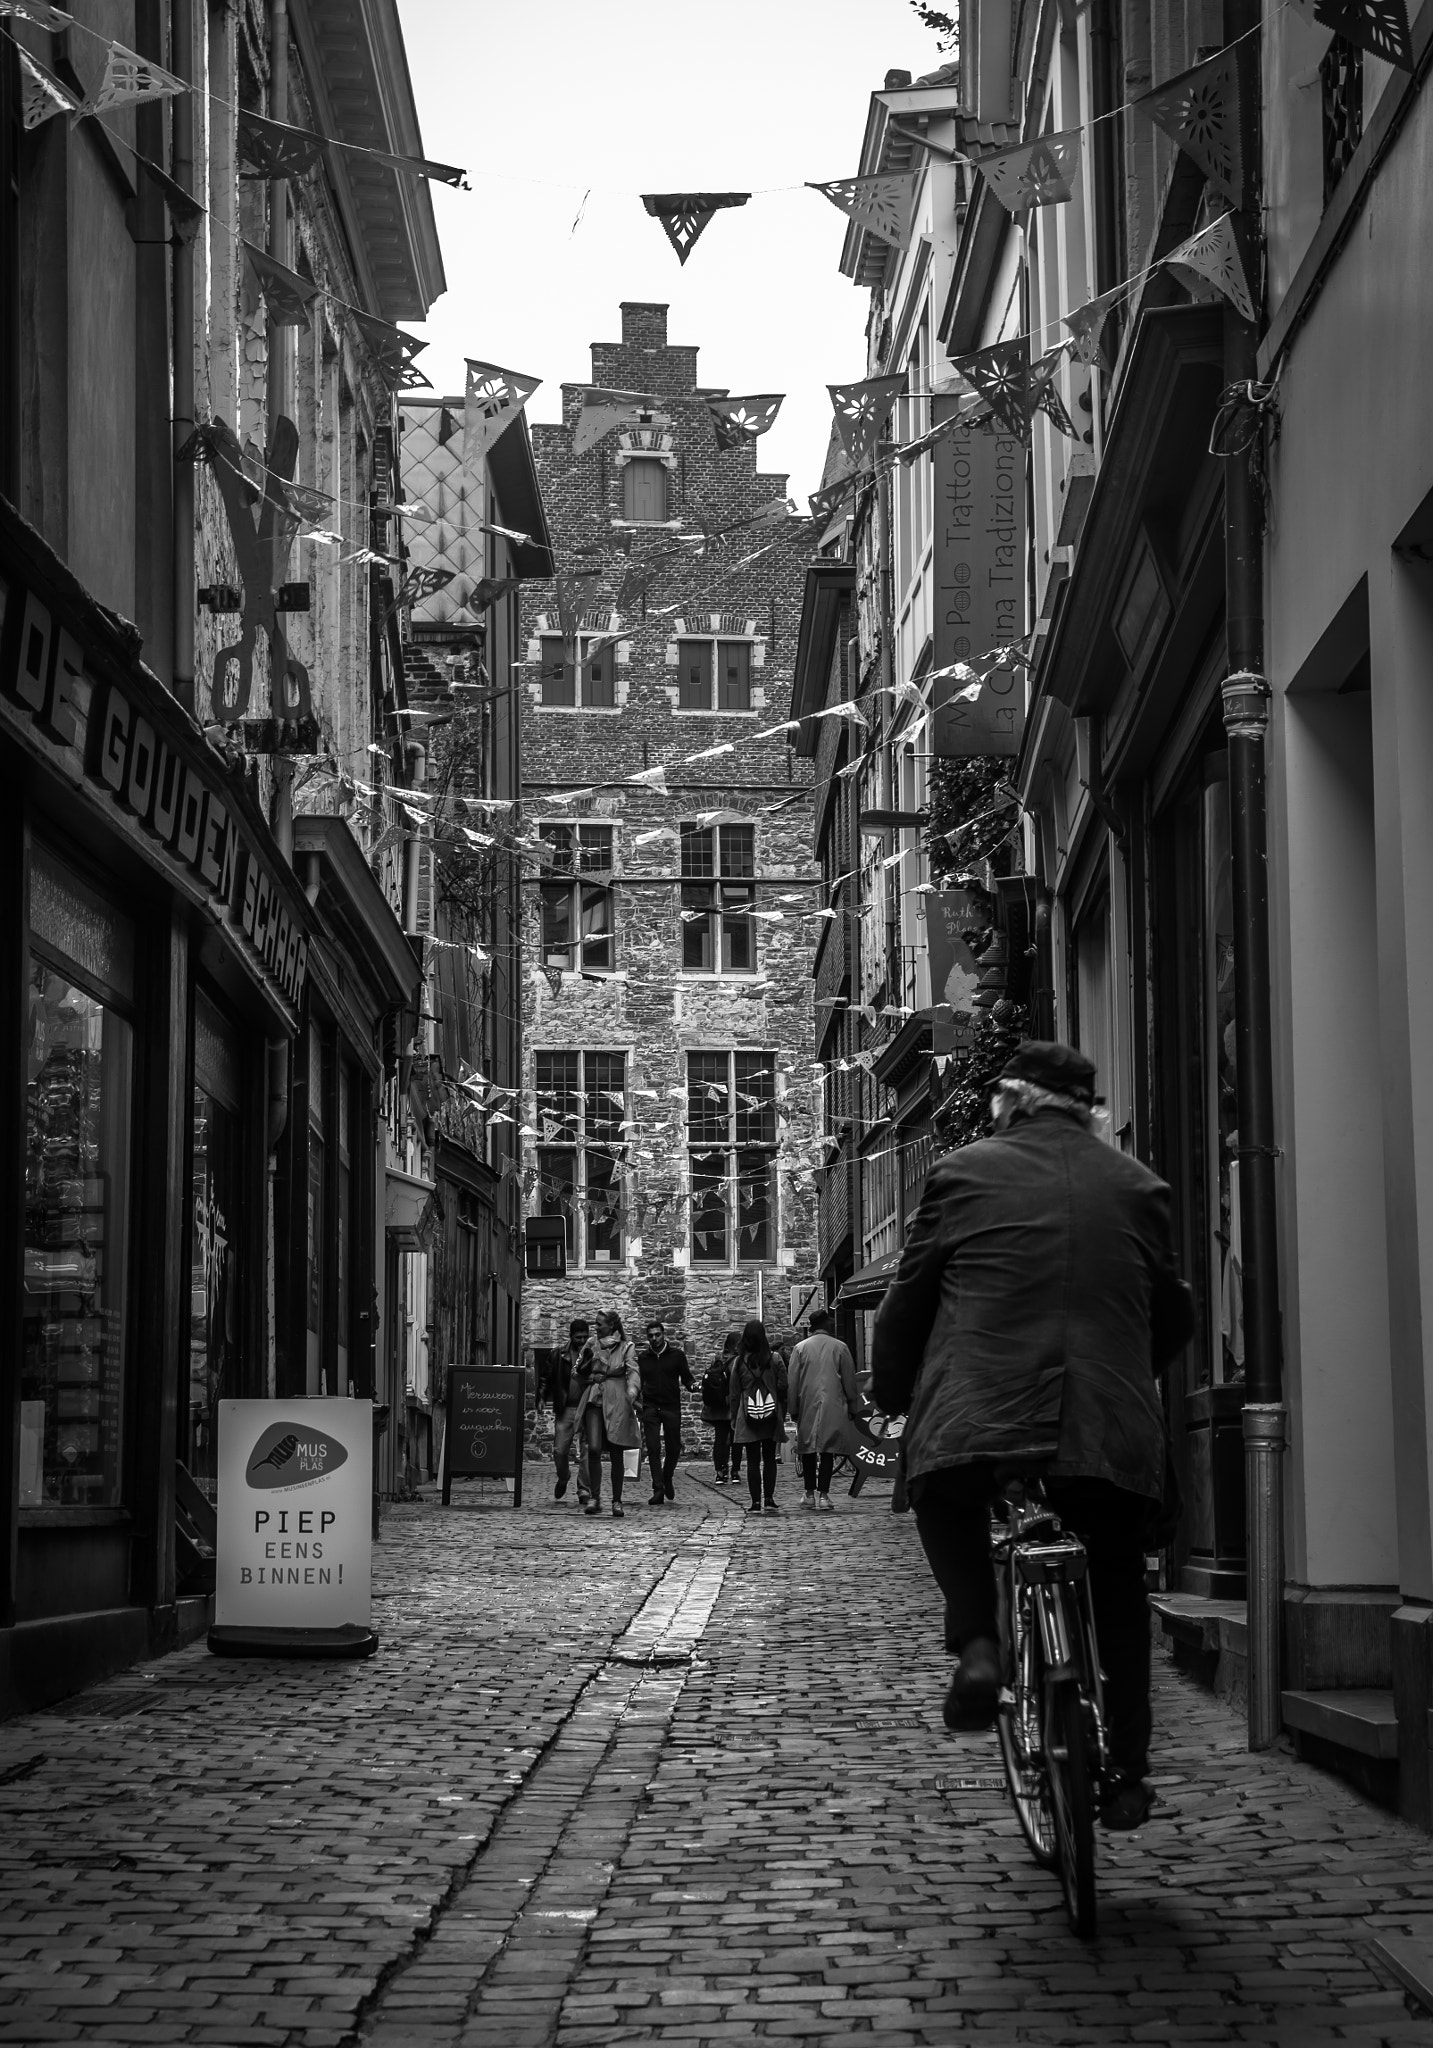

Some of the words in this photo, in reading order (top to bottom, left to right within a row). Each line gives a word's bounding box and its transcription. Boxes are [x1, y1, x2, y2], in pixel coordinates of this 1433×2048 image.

[946, 425, 974, 547] Trattoria
[941, 562, 971, 625] Polo
[989, 599, 1017, 696] Cuina
[990, 706, 1017, 735] La
[16, 588, 85, 747] DE
[102, 686, 239, 906] GOUDEN
[243, 852, 308, 1012] SCHAAR
[297, 1444, 327, 1458] MUS
[300, 1462, 324, 1471] PLAS
[255, 1511, 336, 1534] PIEP
[265, 1542, 323, 1559] EENS
[240, 1564, 343, 1585] BINNEN!
